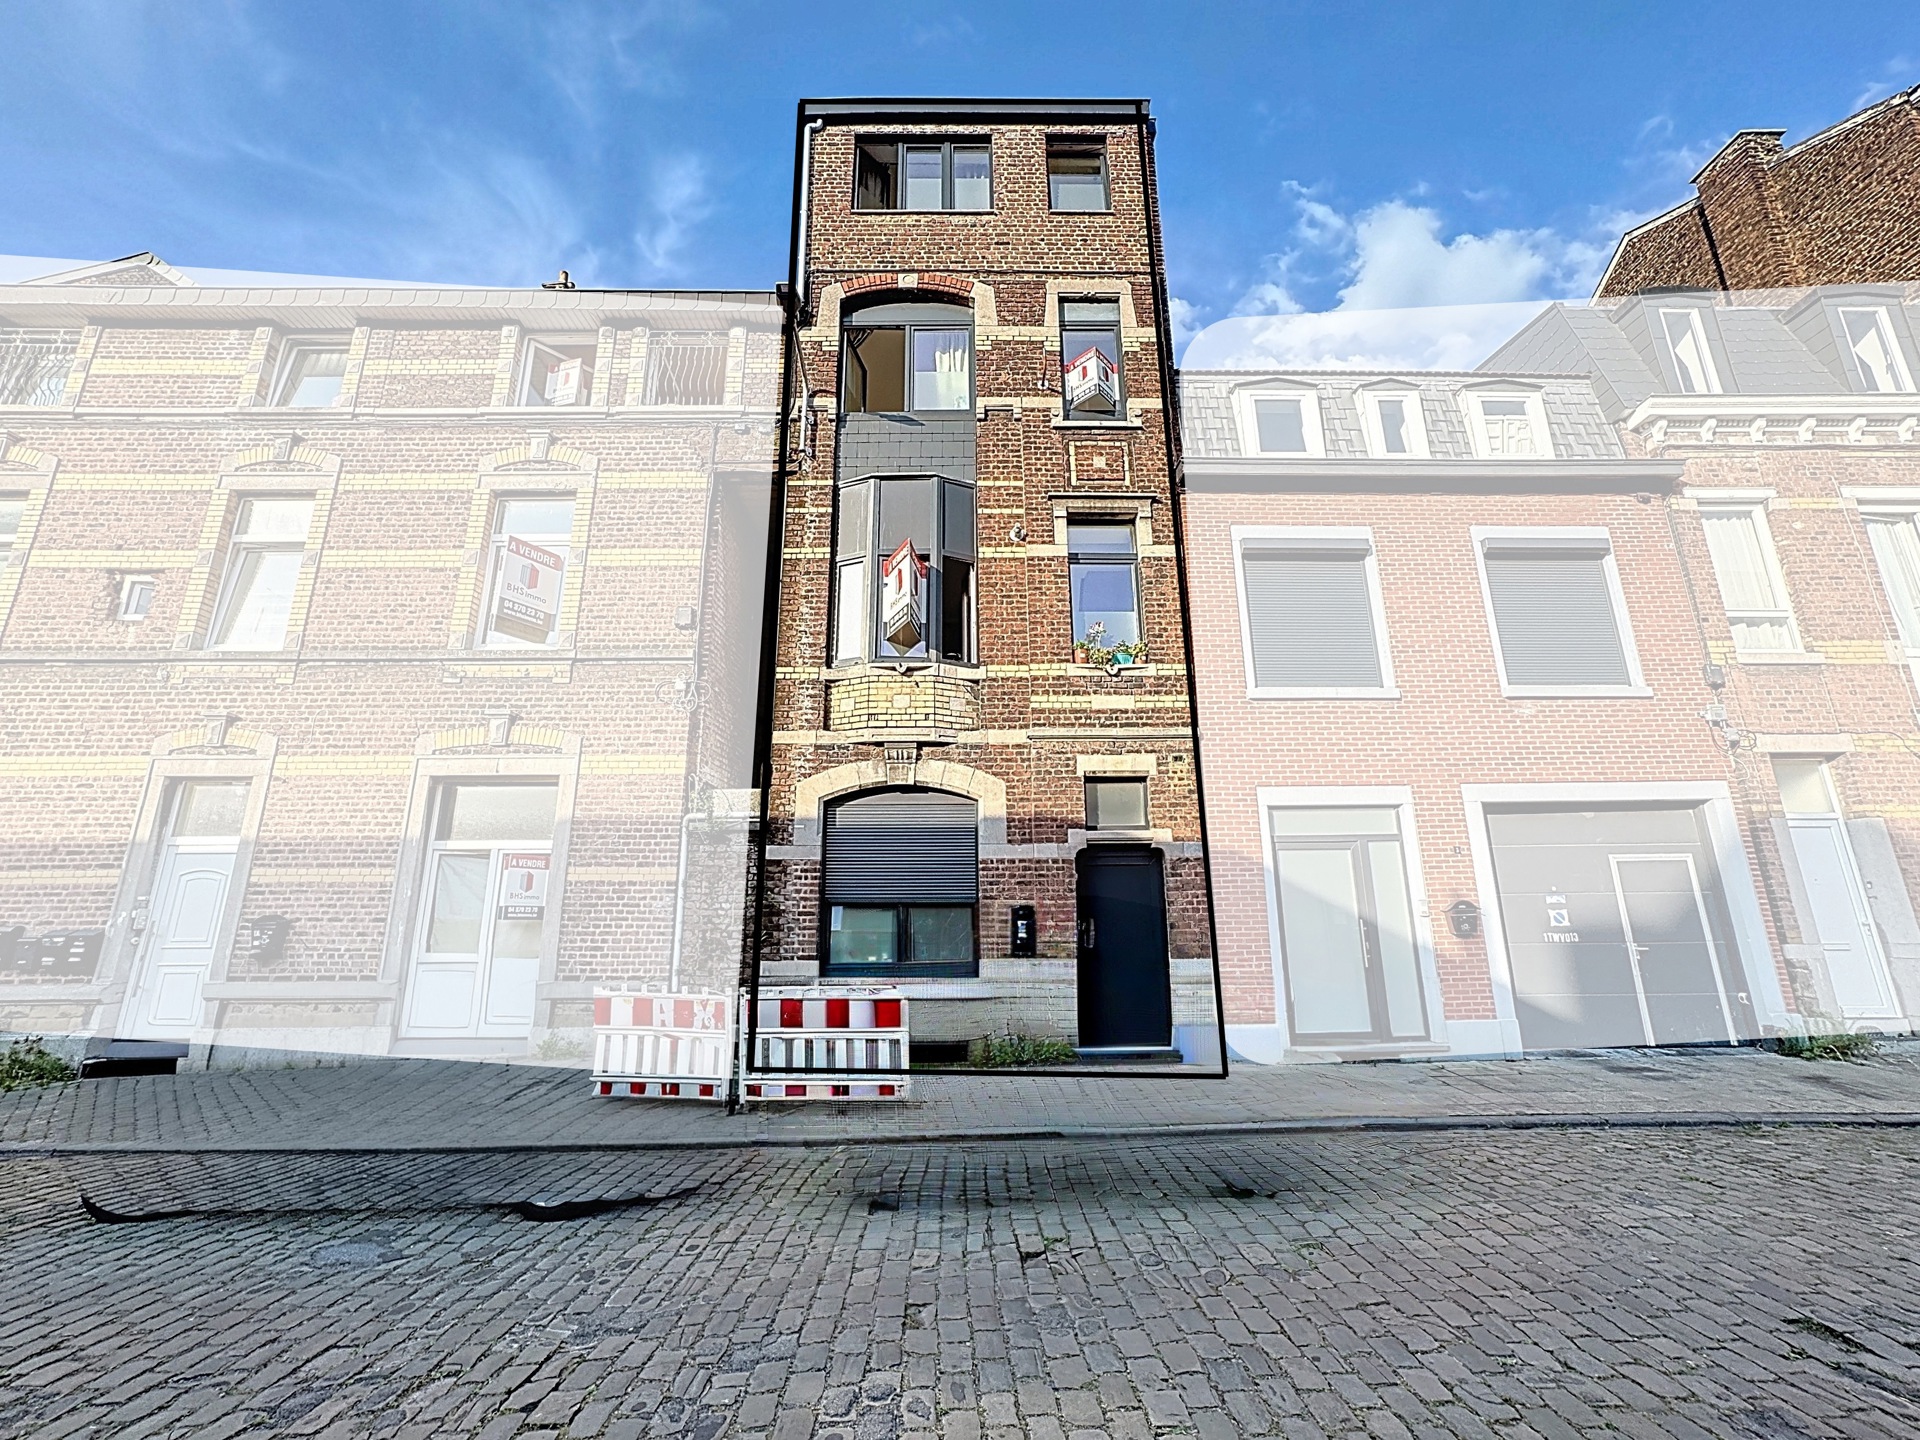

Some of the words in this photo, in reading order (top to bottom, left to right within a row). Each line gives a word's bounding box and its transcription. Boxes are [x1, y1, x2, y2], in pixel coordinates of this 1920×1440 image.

[509, 541, 517, 551] A
[519, 545, 556, 568] VENDRE
[511, 858, 517, 867] A
[518, 859, 547, 869] VENDRE
